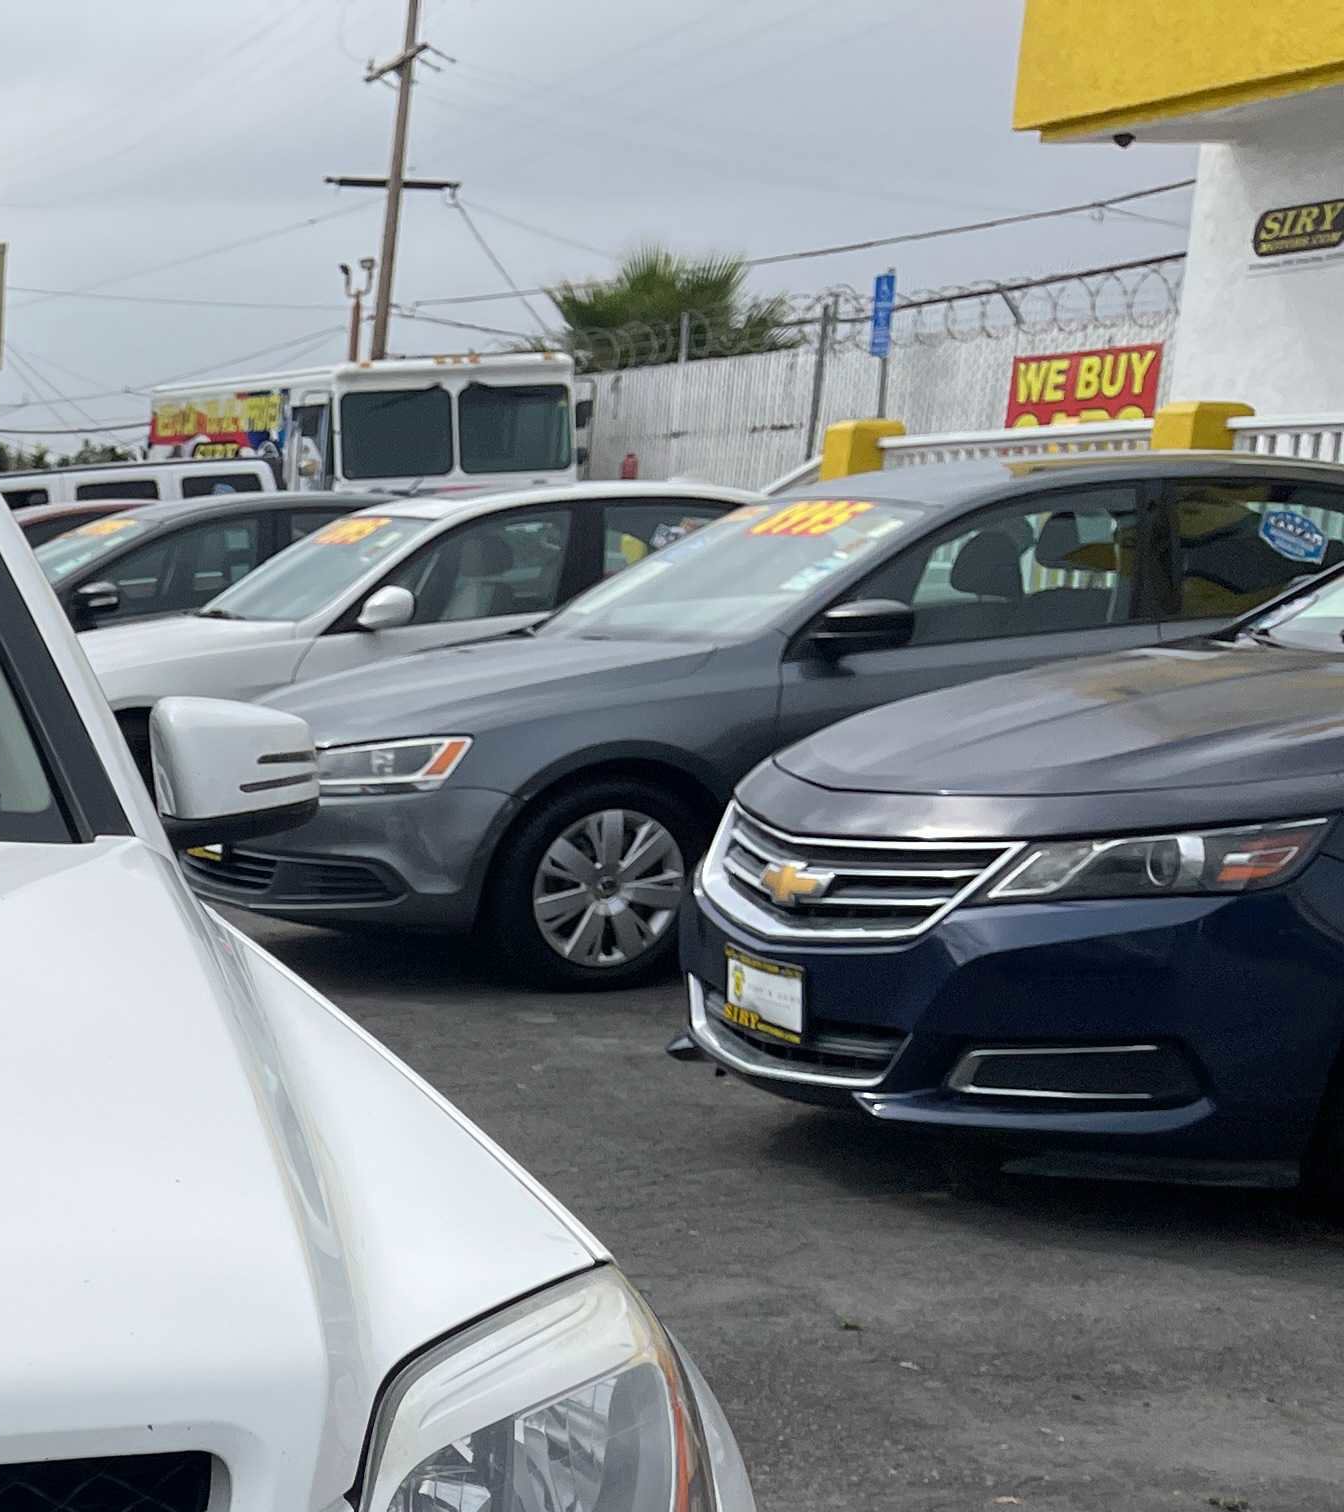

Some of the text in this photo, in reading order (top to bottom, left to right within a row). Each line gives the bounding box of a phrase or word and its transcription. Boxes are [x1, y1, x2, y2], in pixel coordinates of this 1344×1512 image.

[1260, 202, 1344, 240] SIRY
[1016, 350, 1157, 404] WE BUY
